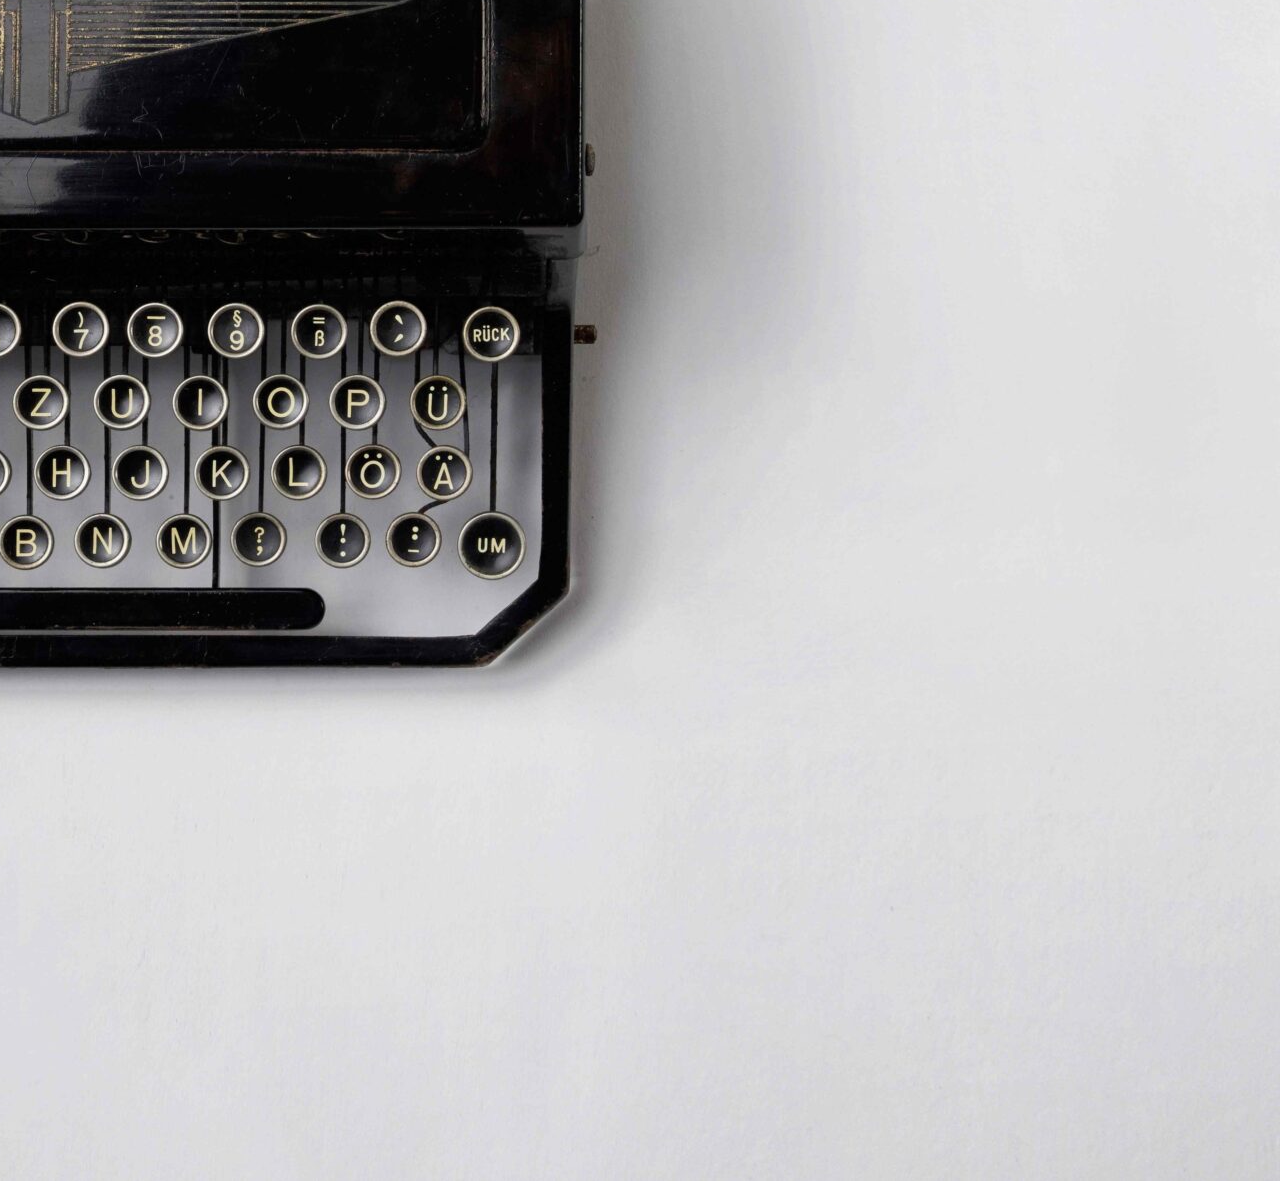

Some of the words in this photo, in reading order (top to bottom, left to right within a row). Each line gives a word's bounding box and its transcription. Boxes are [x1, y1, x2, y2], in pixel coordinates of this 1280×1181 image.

[74, 329, 91, 349] 7
[149, 326, 162, 346] 8
[230, 331, 244, 350] 9
[474, 326, 510, 344] RÜCK
[31, 389, 53, 419] Z
[112, 389, 134, 418] U
[198, 389, 202, 416] I
[268, 387, 296, 419] O
[348, 390, 371, 417] P
[428, 386, 448, 421] Ü
[53, 459, 72, 488] H
[131, 460, 151, 488] J
[213, 460, 233, 488] K
[289, 458, 309, 488] L
[361, 454, 386, 488] Ö
[434, 456, 454, 490] Ä
[17, 529, 37, 557] B
[93, 528, 114, 556] N
[172, 528, 197, 556] M
[478, 538, 505, 553] UM
